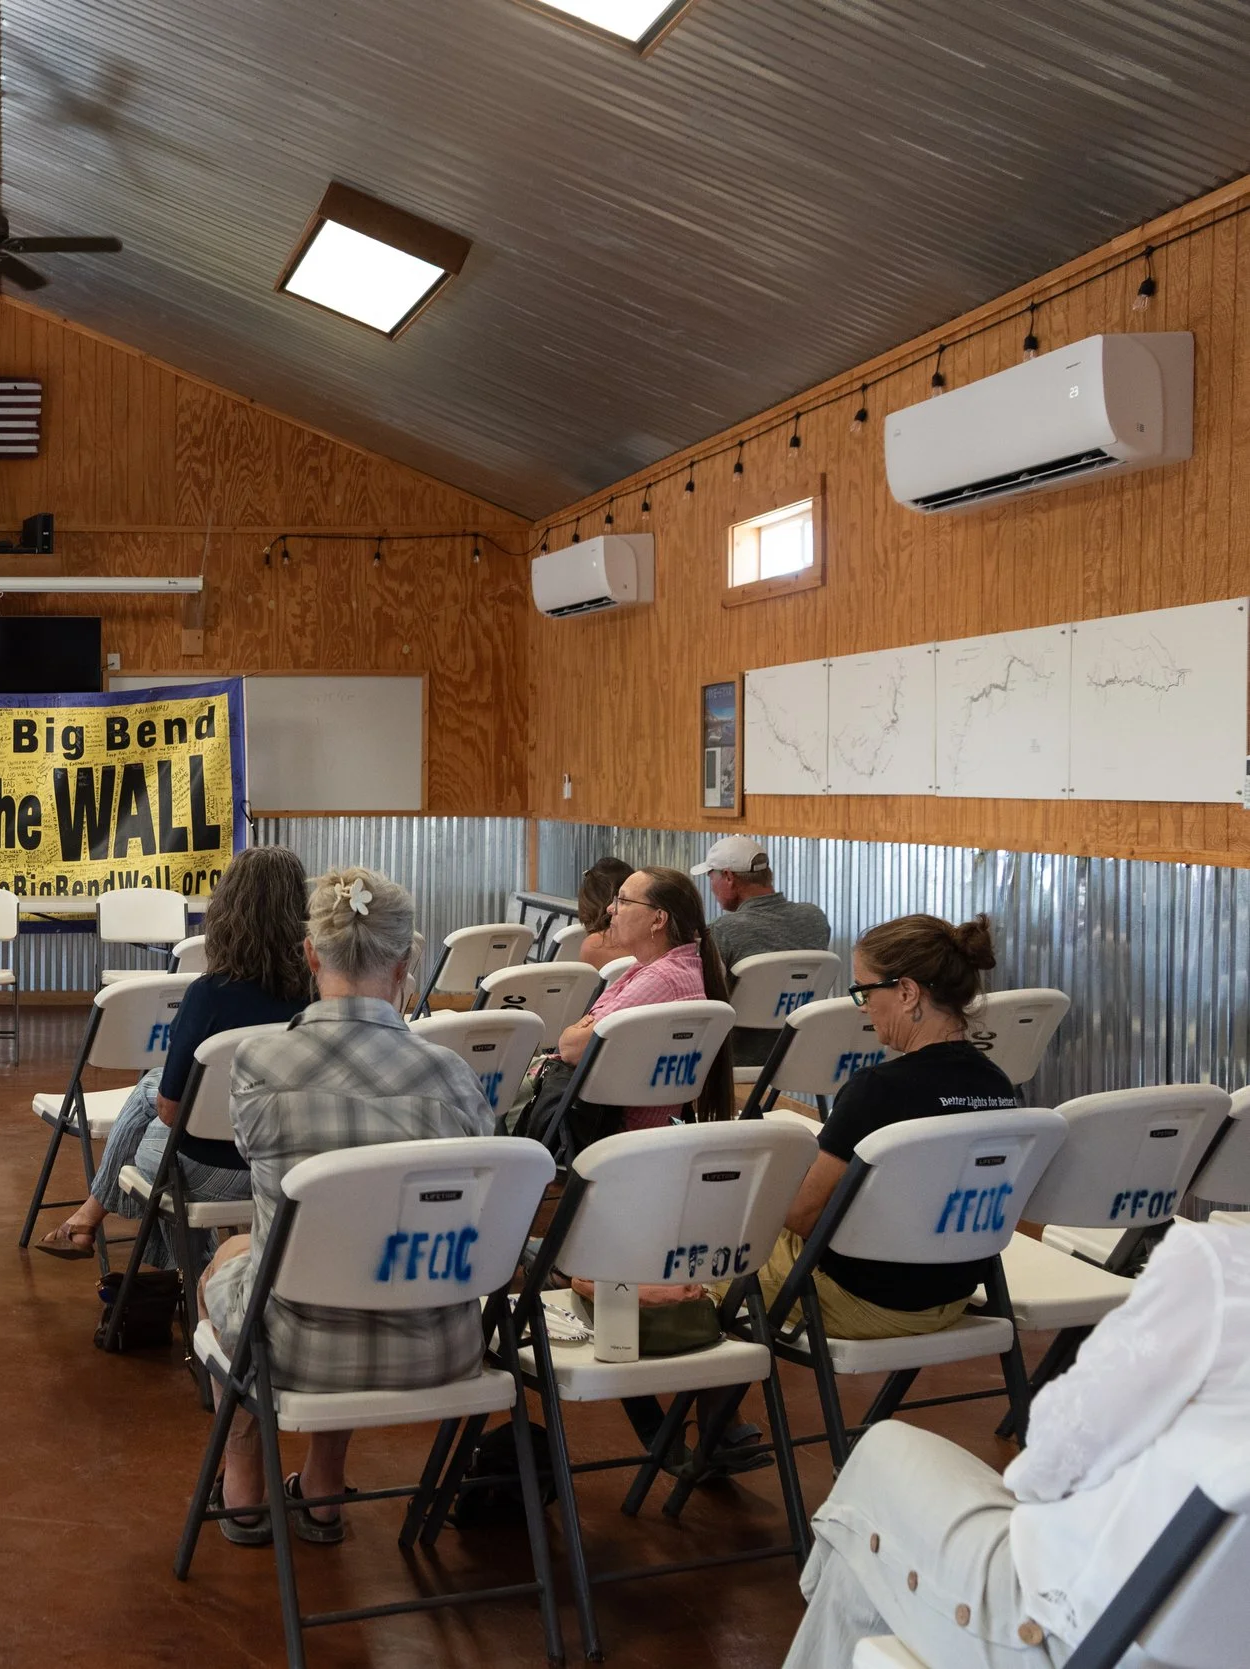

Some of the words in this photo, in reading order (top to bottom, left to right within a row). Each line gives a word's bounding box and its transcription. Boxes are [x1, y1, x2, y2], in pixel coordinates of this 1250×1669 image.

[1069, 385, 1079, 399] 23
[13, 717, 85, 760] Big
[107, 705, 215, 751] Bend
[53, 755, 220, 861] WALL
[939, 1096, 966, 1107] Better
[967, 1096, 987, 1110] Lights
[988, 1096, 998, 1107] for
[663, 1243, 750, 1279] FFOC
